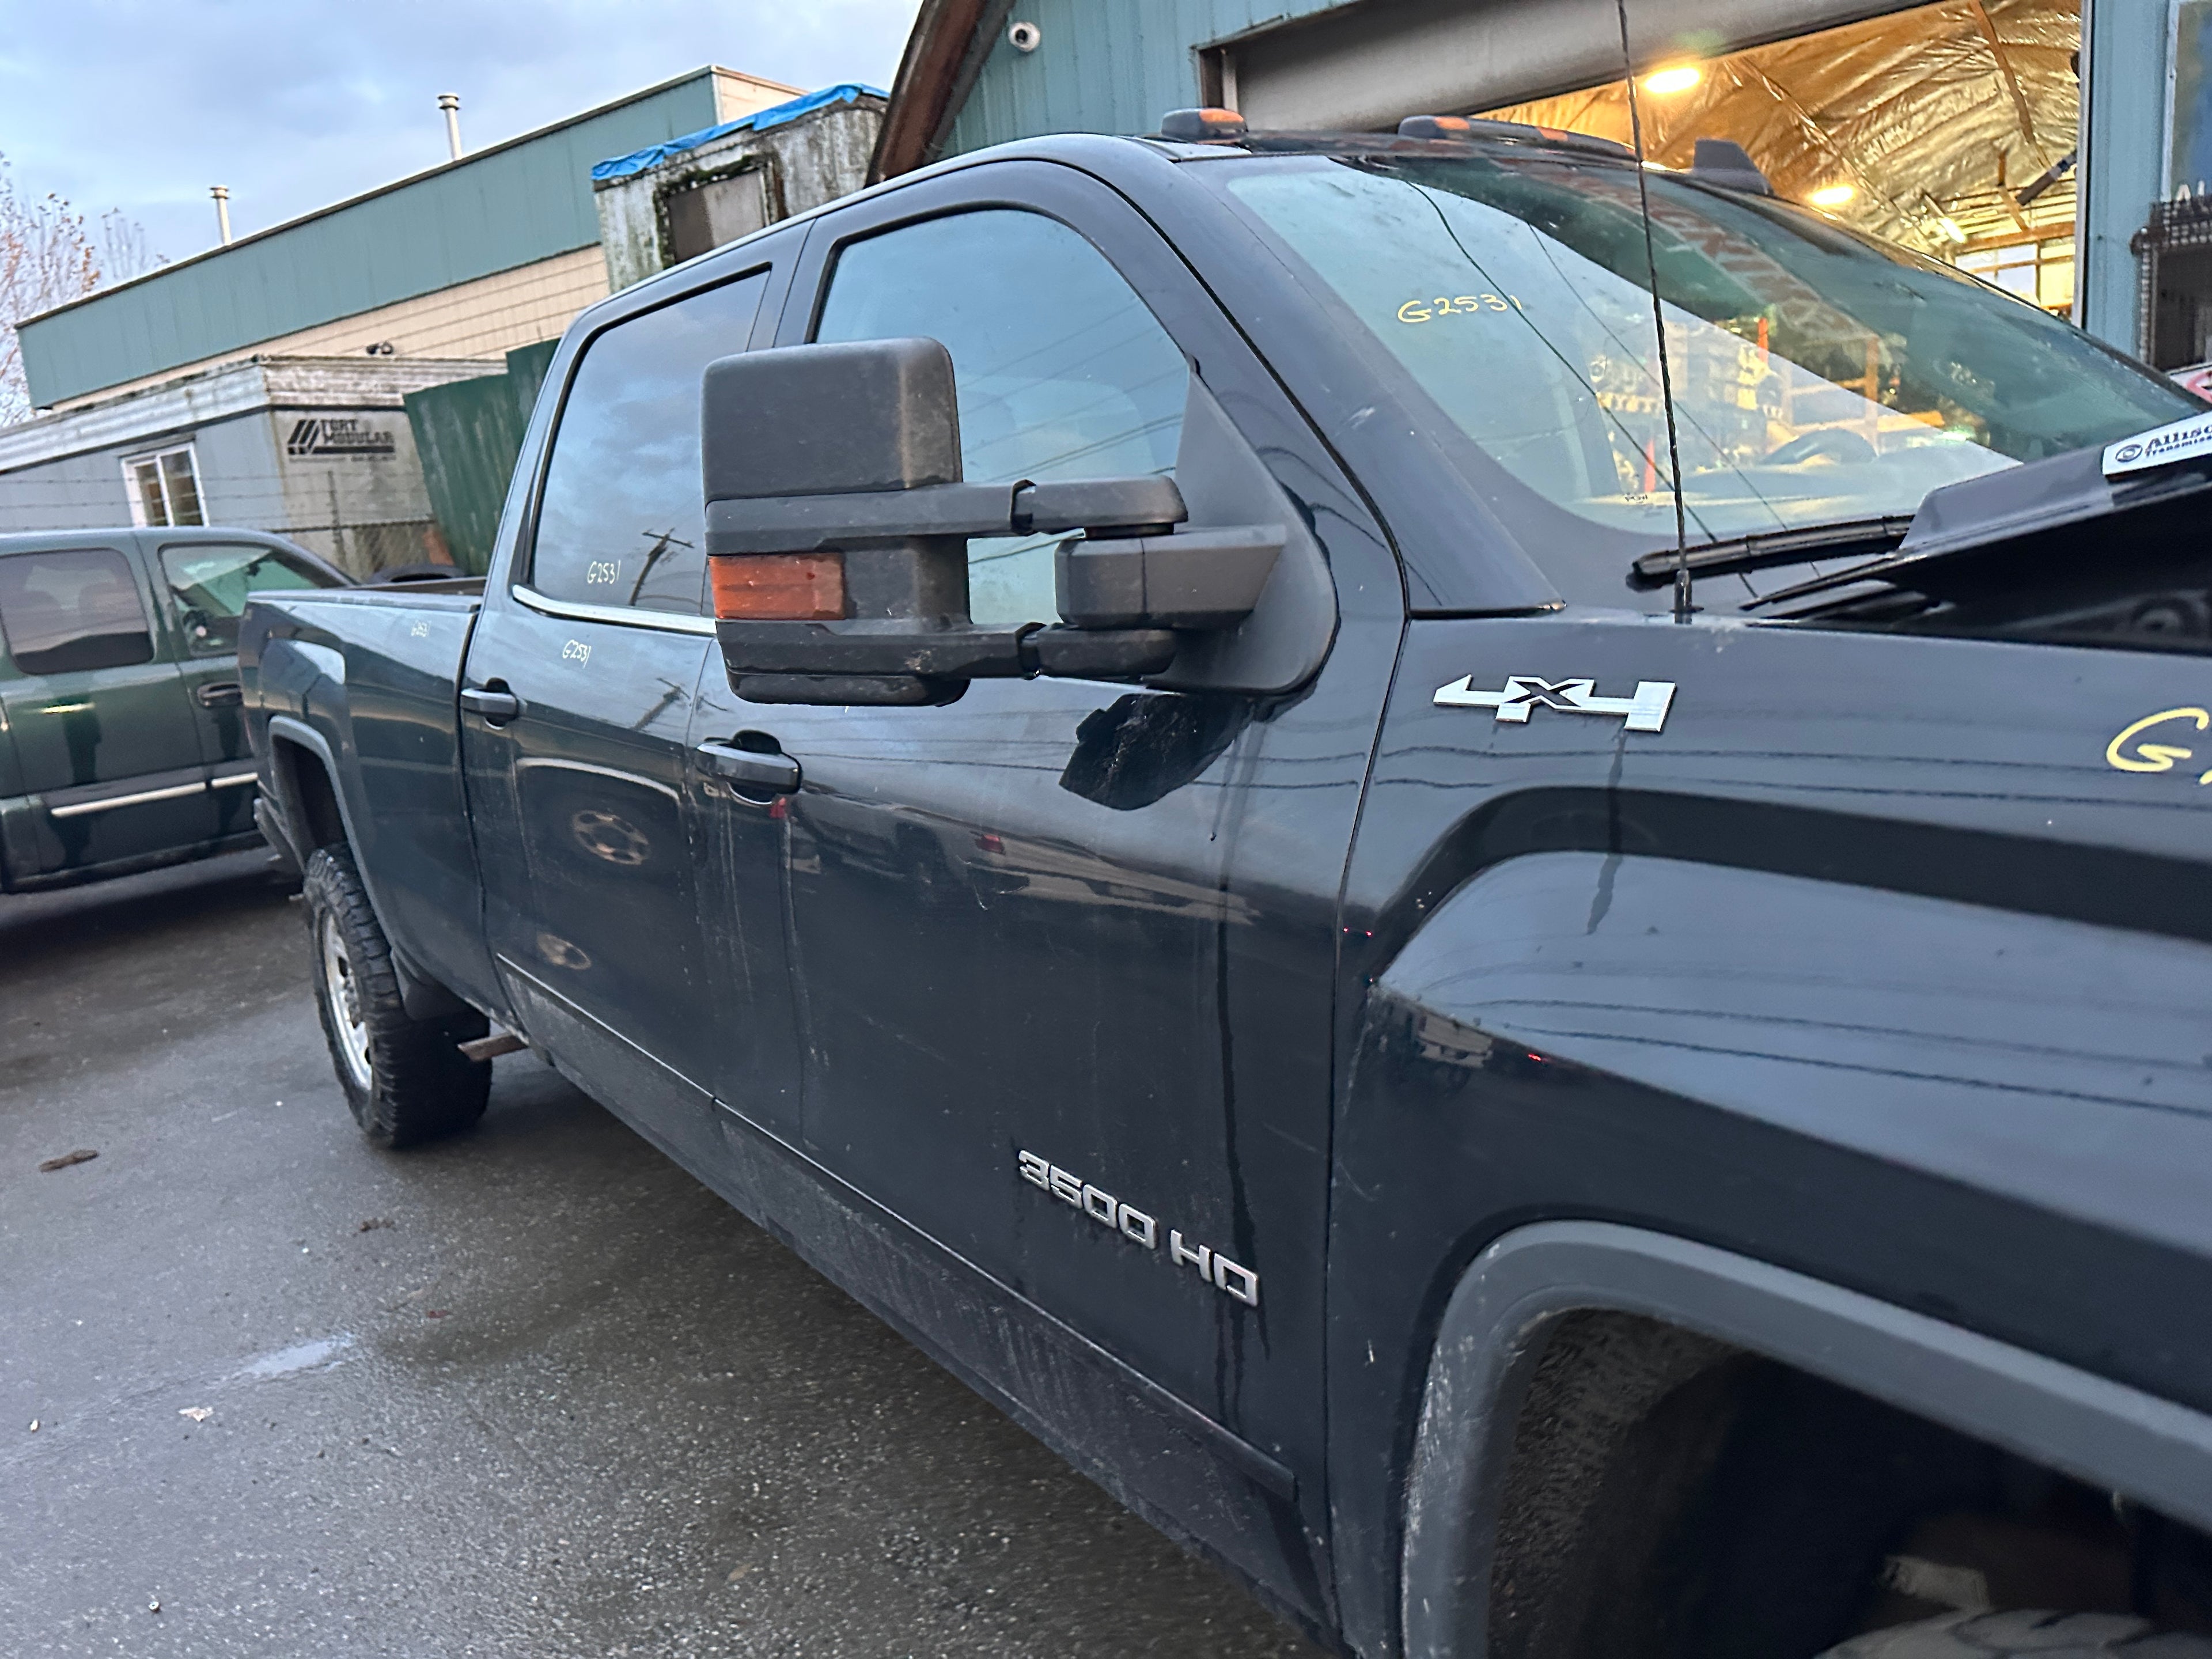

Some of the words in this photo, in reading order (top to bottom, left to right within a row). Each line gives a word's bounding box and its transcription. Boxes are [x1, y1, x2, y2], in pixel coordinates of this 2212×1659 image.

[1397, 294, 1522, 323] G2531
[587, 559, 621, 584] G2531
[562, 639, 592, 669] G2531
[2106, 707, 2212, 785] G
[1018, 1149, 1158, 1249] 3500
[1170, 1229, 1258, 1306] HD
